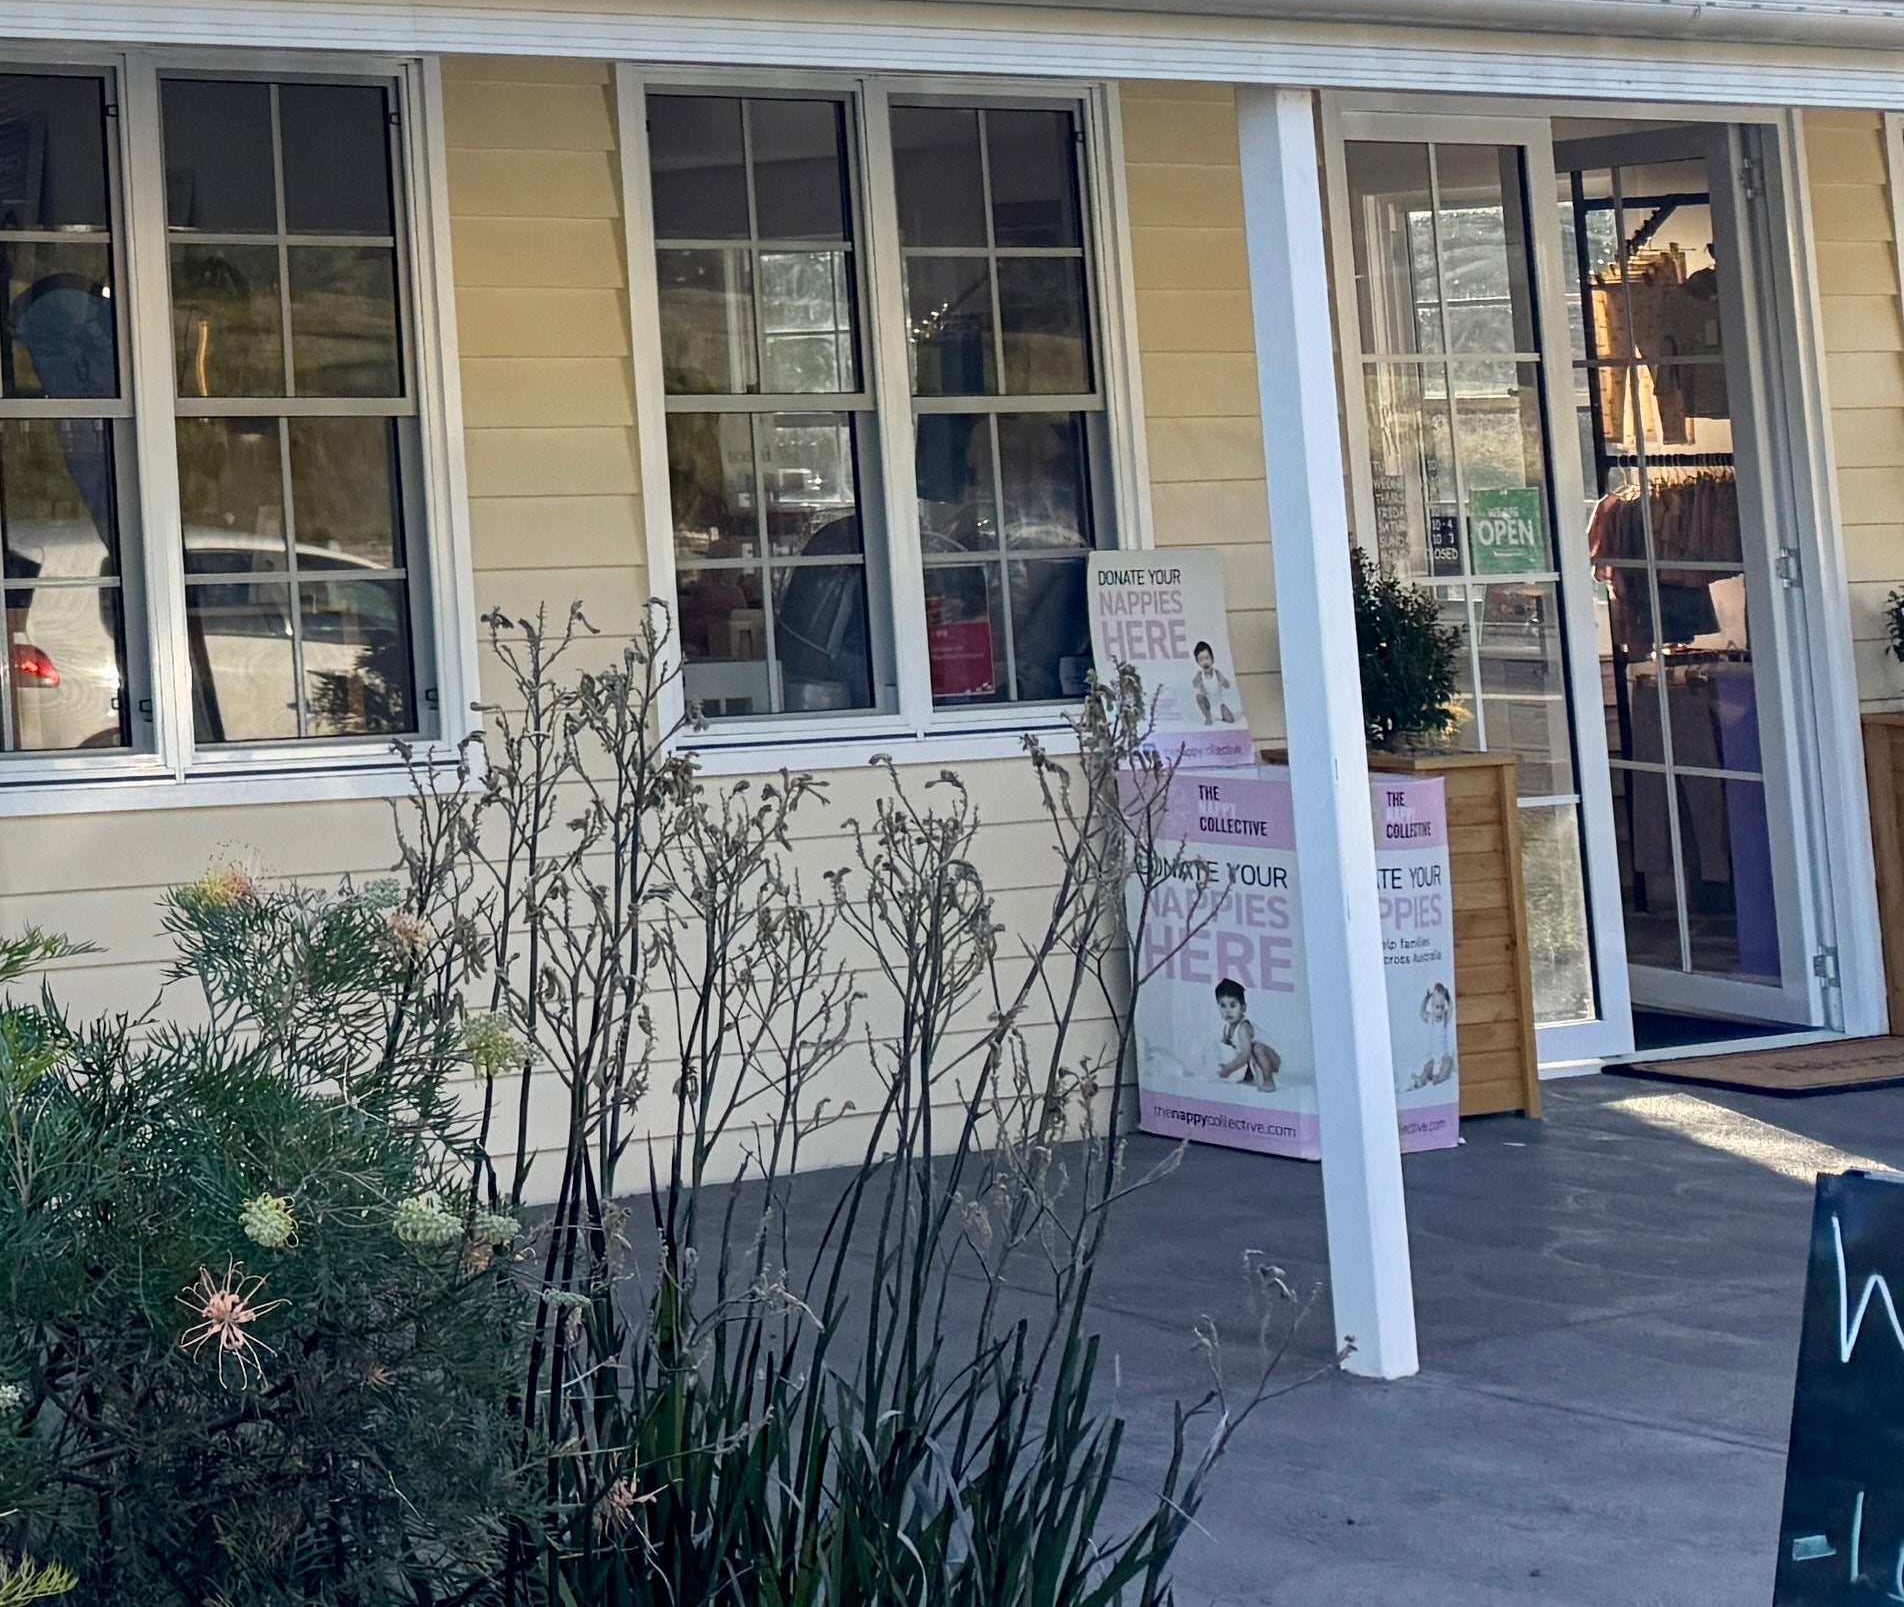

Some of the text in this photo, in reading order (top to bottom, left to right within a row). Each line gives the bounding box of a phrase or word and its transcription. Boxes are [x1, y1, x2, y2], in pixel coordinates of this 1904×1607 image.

[1477, 518, 1536, 547] OPEN
[1098, 568, 1181, 586] DONATE YOUR
[1099, 590, 1184, 617] NAPPIES
[1102, 618, 1191, 662] HERE
[1198, 785, 1221, 802] THE
[1387, 791, 1405, 807] THE
[1199, 816, 1268, 837] COLLECTIVE
[1227, 862, 1288, 889] YOUR
[1409, 865, 1441, 888] YOUR
[1146, 887, 1290, 930] NAPPIES
[1379, 893, 1442, 931] PPIES
[1144, 922, 1295, 993] HERE
[1384, 954, 1410, 966] cross
[1152, 1104, 1297, 1138] thenappycollective.com
